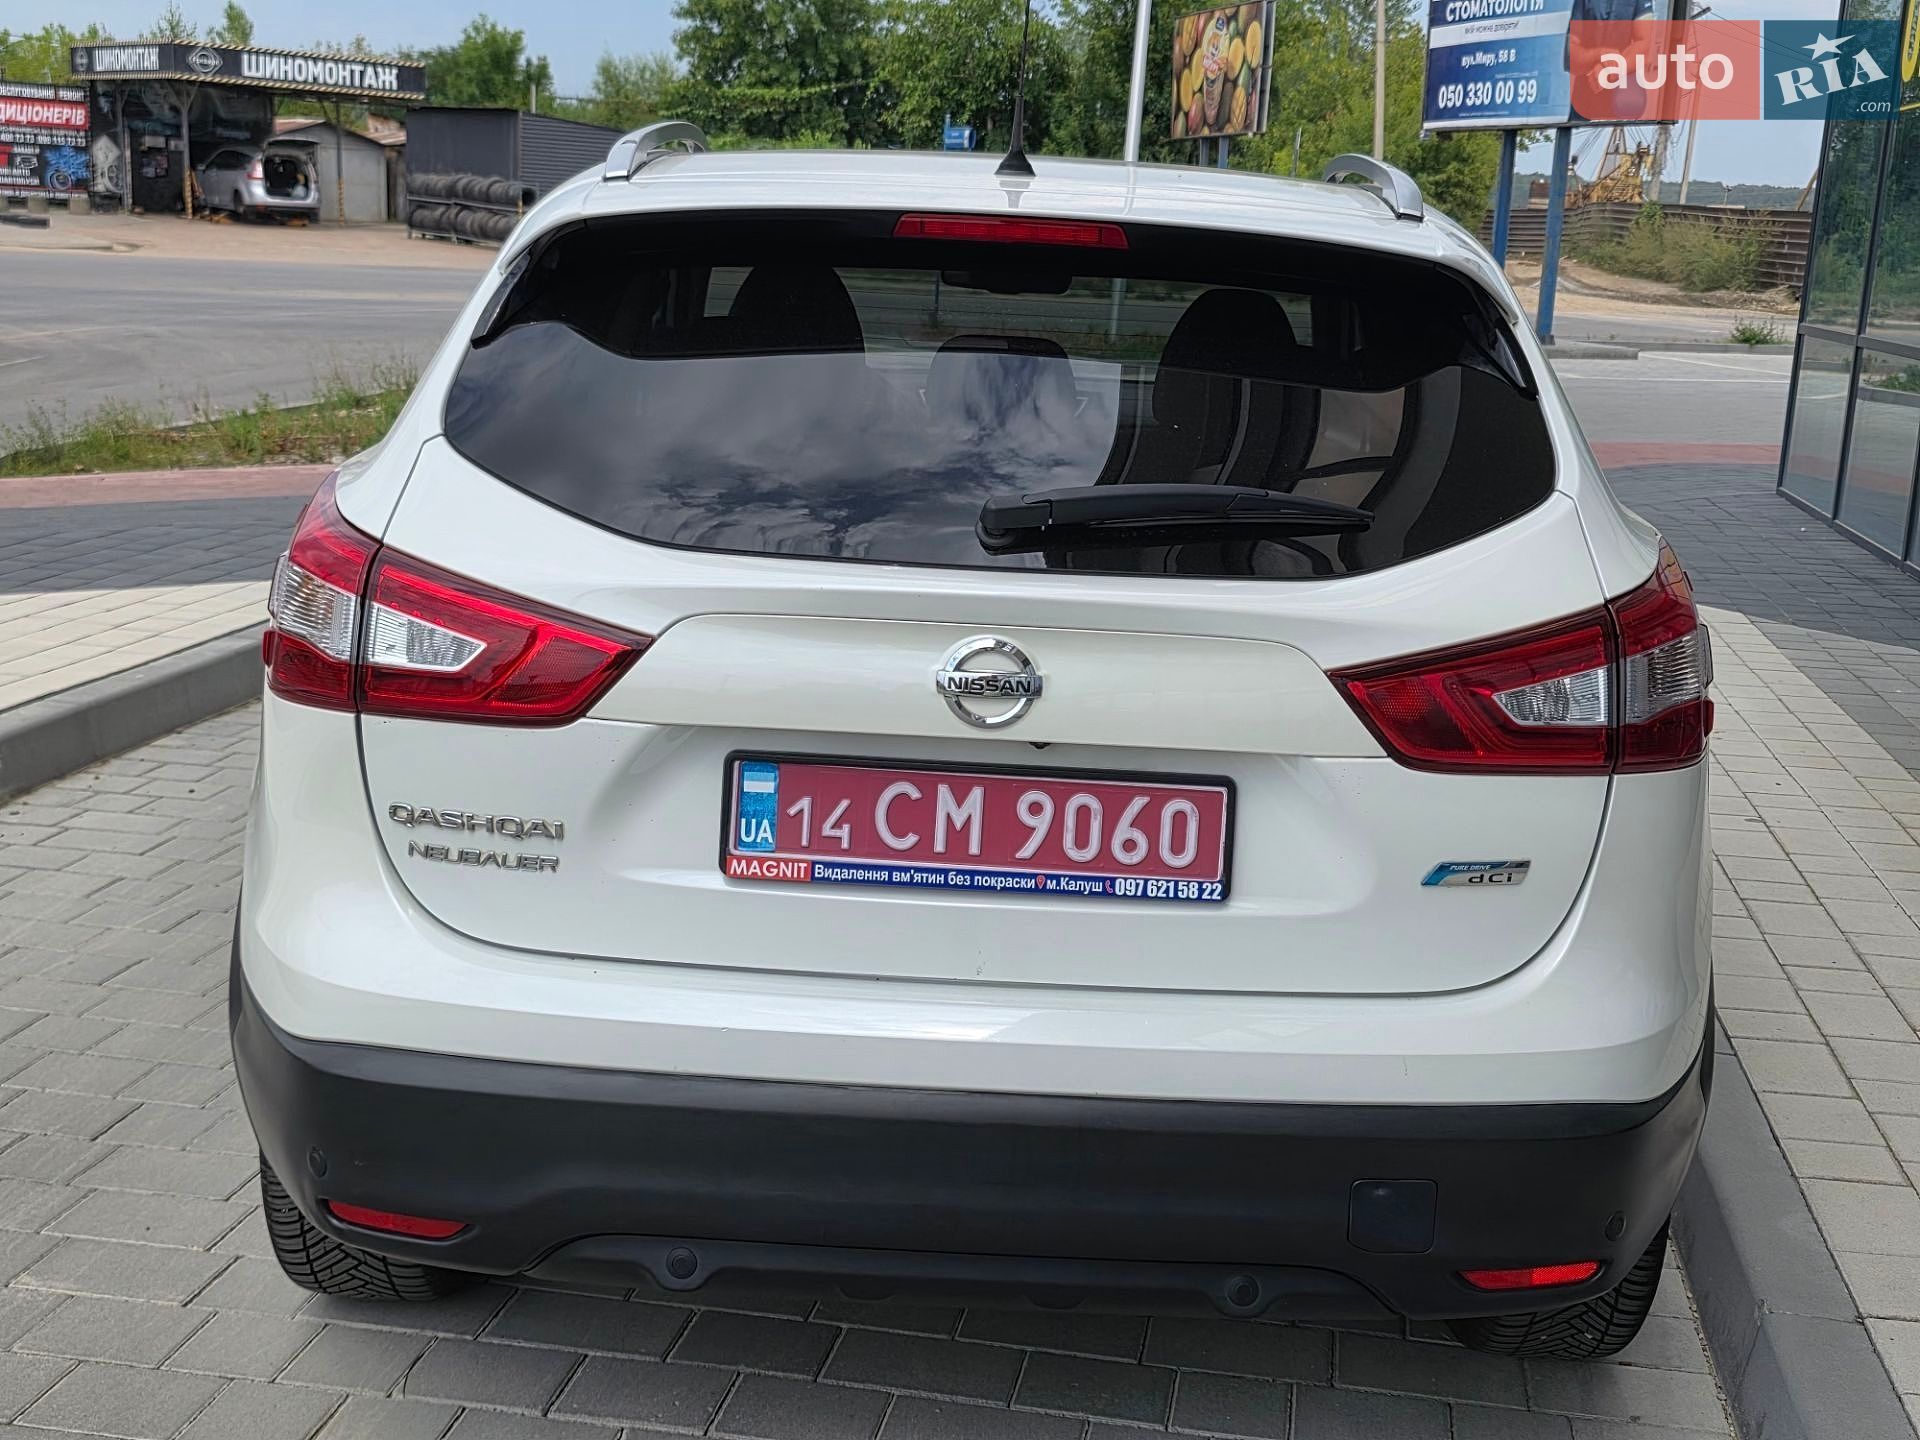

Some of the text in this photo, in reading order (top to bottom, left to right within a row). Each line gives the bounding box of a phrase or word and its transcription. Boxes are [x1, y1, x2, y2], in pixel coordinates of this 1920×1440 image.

[95, 45, 160, 72] ШИНОМОНТАЖ
[241, 52, 399, 91] ШИНОМОНТАЖ
[1438, 79, 1537, 109] 050 330 00 99
[947, 677, 1031, 693] NISSAN
[388, 802, 565, 841] QASHQAI
[740, 818, 774, 844] UA
[786, 781, 1200, 868] 14 CM 9060
[408, 840, 560, 873] NEUBAUER
[729, 859, 807, 879] MAGNIT
[814, 864, 1035, 890] Видалення вм'ятин без покраски
[1046, 877, 1103, 895] м.Калуш
[1115, 878, 1222, 900] 097 621 58 22
